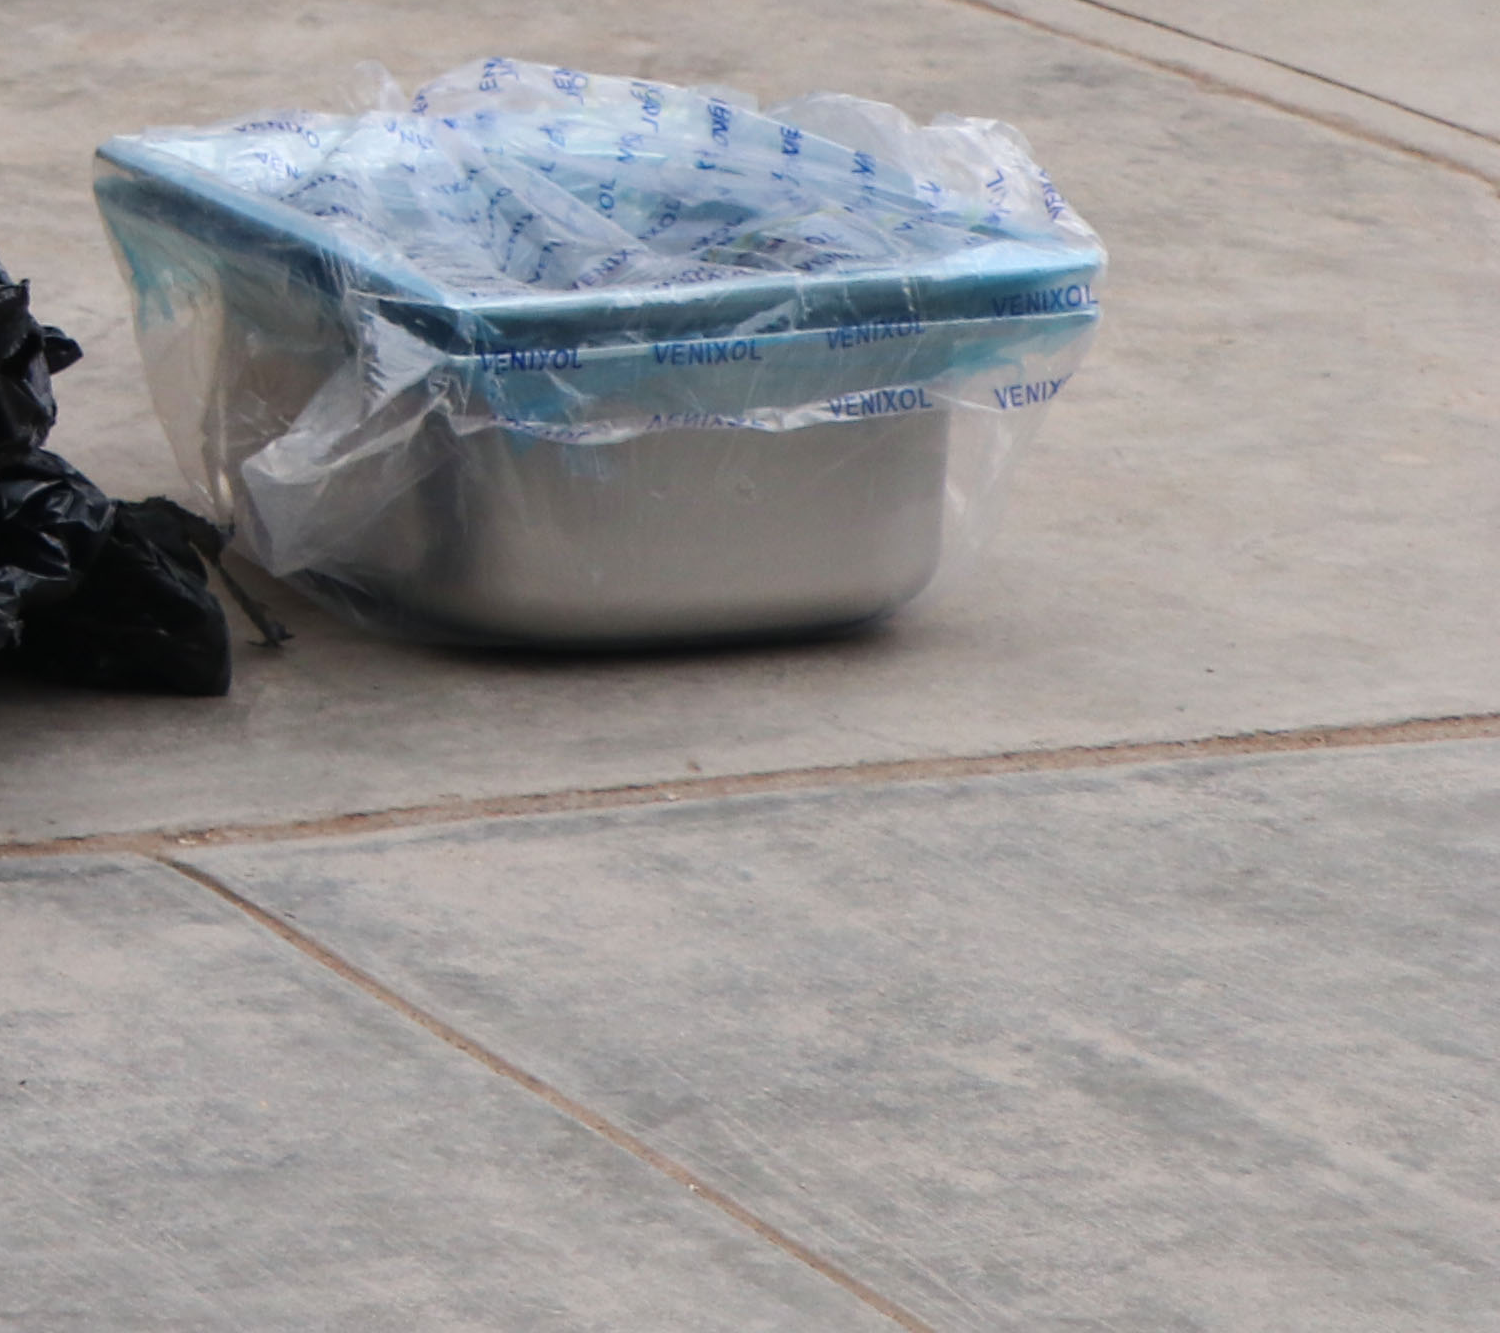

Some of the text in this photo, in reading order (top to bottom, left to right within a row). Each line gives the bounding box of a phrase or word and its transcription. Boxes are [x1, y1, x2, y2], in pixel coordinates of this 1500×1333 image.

[990, 284, 1099, 318] VENIXOL
[826, 314, 926, 350] VENIXOL
[479, 348, 584, 373] VENIXOL
[653, 339, 763, 366] VENIXOL
[828, 388, 934, 419] VENIXOL
